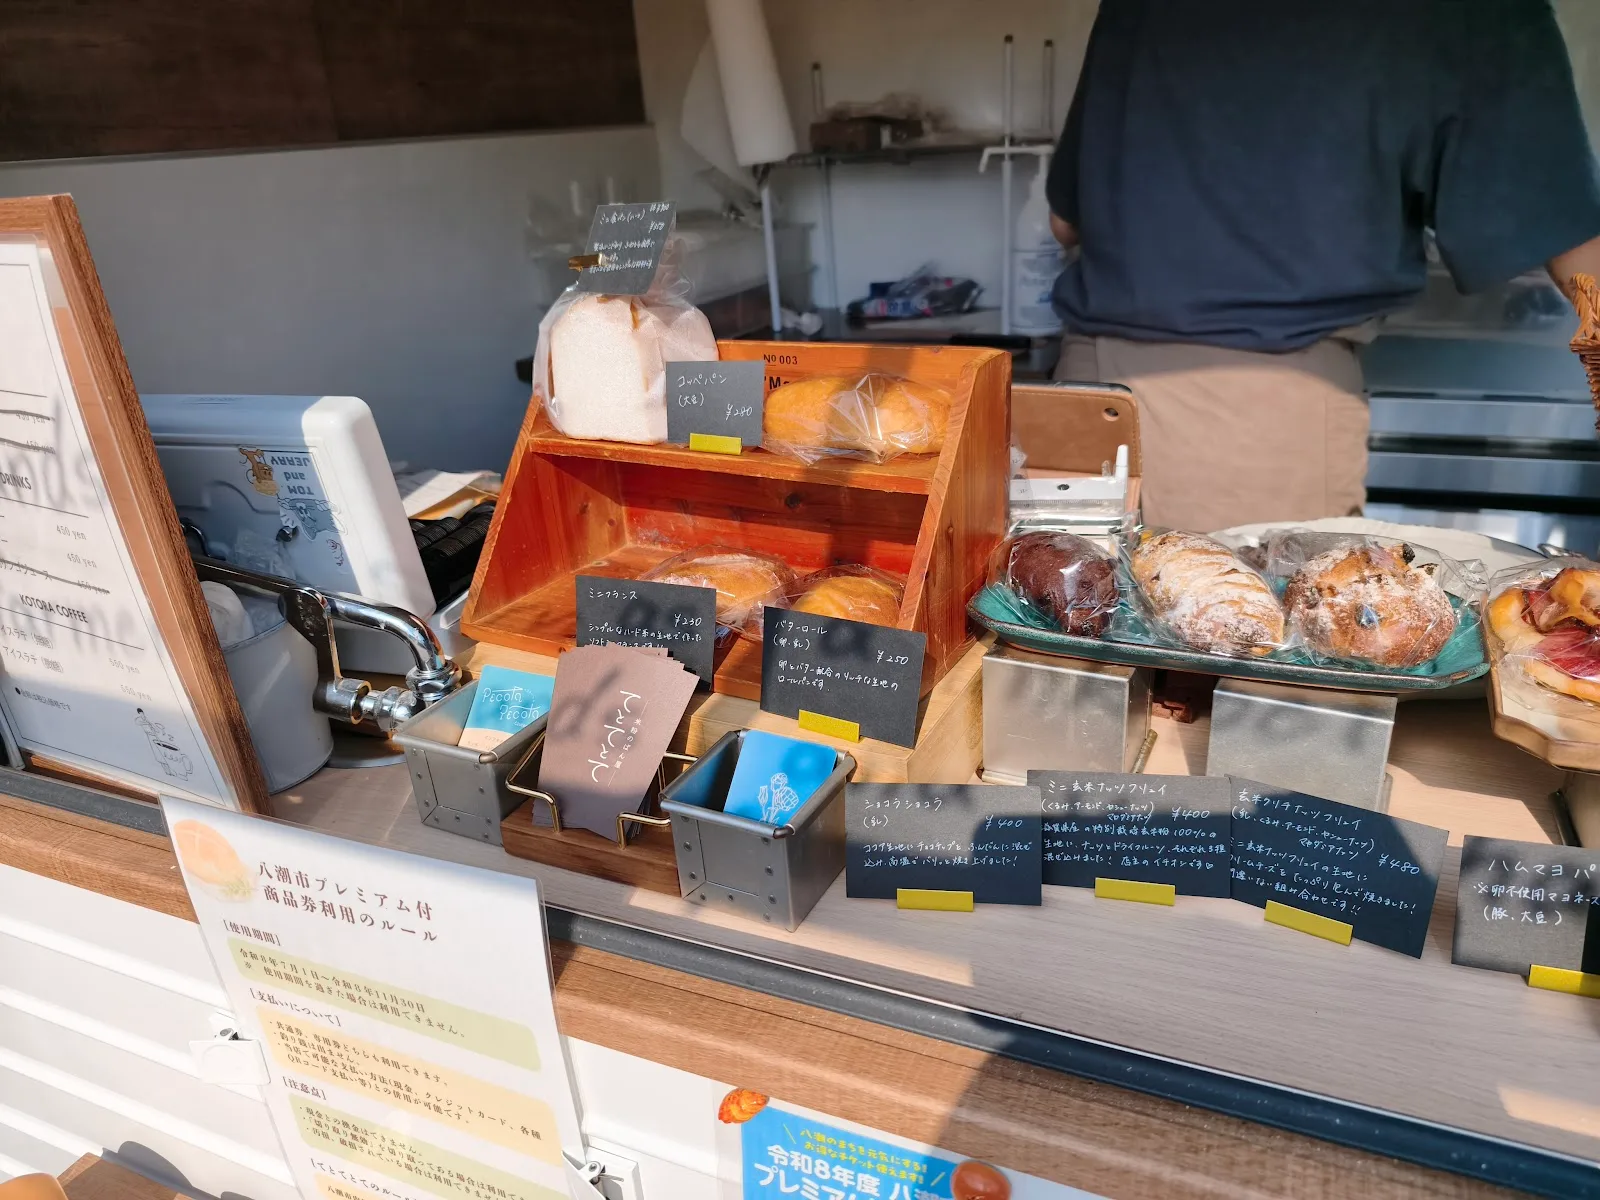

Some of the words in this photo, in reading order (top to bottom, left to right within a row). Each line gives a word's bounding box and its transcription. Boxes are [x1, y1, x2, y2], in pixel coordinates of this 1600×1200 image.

[779, 355, 798, 365] 003
[677, 372, 727, 388] コッペパン
[725, 403, 753, 421] ¥280
[270, 456, 311, 467] JERRY
[283, 471, 306, 481] and
[287, 485, 315, 496] TOM
[56, 524, 71, 537] 450
[71, 529, 87, 540] yen
[66, 552, 81, 564] 450
[82, 558, 98, 569] yen
[589, 587, 638, 600] ミニフランス
[19, 593, 56, 614] KOTORA
[55, 604, 88, 623] COFFEE
[674, 613, 703, 628] ¥230
[775, 619, 828, 635] バターロール
[876, 649, 909, 666] ¥250
[778, 659, 899, 691] 卵とバター配合のリッチな生地の
[587, 690, 642, 783] てとてとて
[1047, 779, 1168, 796] ミニ玄米ナッツフリュイ
[863, 797, 943, 812] ショコラショコラ
[1237, 787, 1363, 831] 玄米クリチナッツフリュイ
[863, 814, 889, 829] （乳）
[985, 813, 1024, 831] ¥400
[1170, 806, 1211, 822] ¥400
[1378, 853, 1420, 875] ¥480
[258, 861, 433, 921] 八潮市プレミアム付
[263, 884, 439, 942] 商品券利用のルール
[1483, 904, 1563, 926] （豚、大豆）
[767, 1144, 881, 1198] 令和8年度
